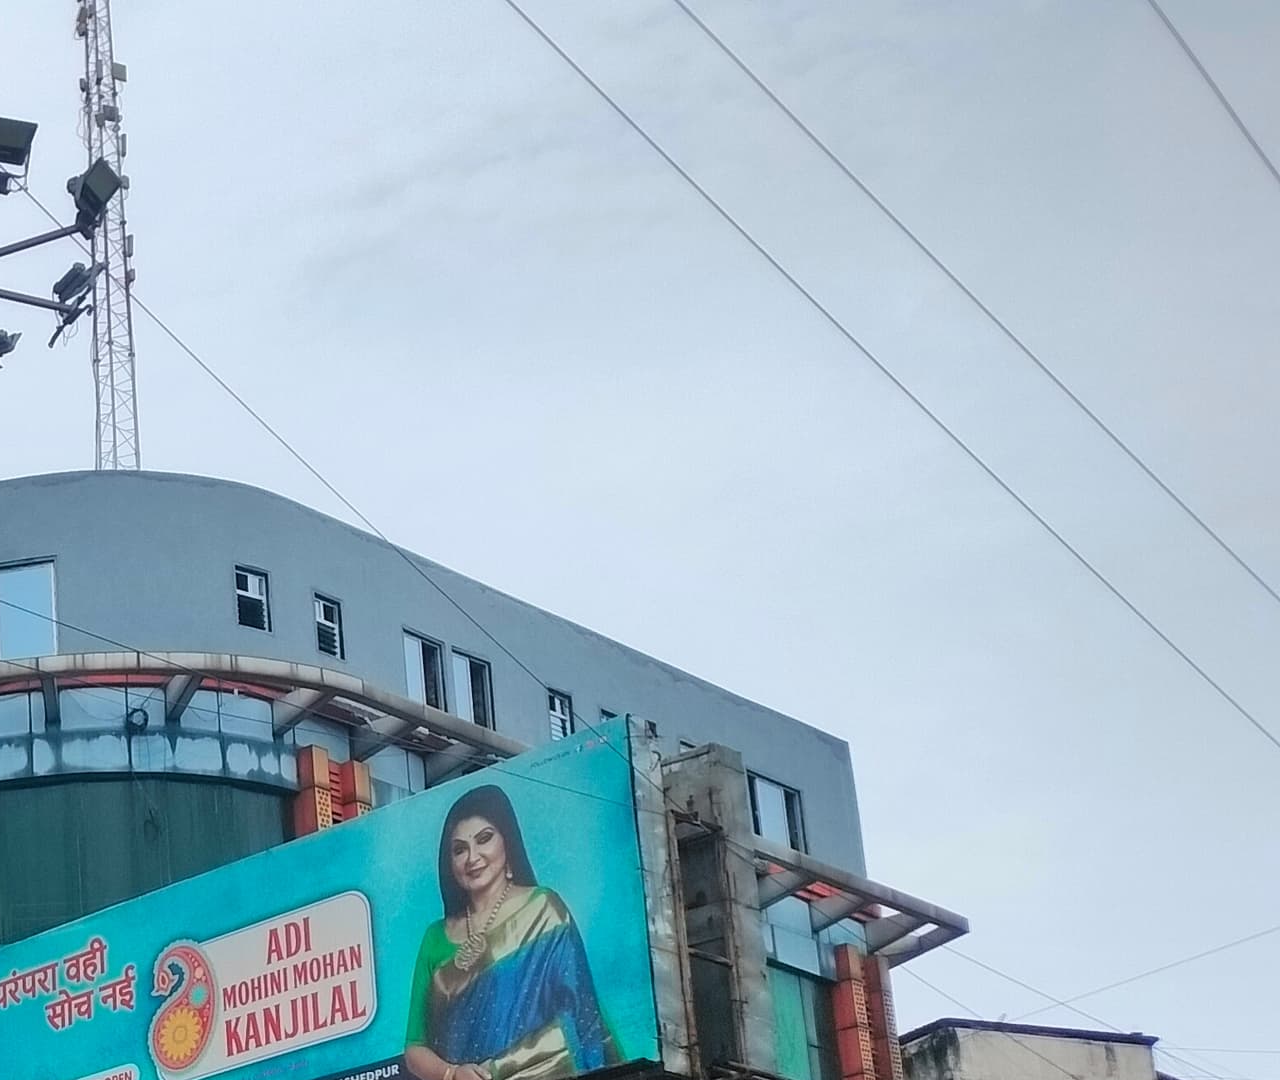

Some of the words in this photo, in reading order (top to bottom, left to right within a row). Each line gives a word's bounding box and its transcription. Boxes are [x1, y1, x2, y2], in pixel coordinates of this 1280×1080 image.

[64, 937, 108, 983] वही
[266, 917, 313, 966] ADI
[45, 991, 94, 1033] सोच
[100, 966, 136, 1011] नई
[222, 964, 290, 1012] MOHINI
[292, 943, 363, 988] MOHAN
[224, 979, 368, 1058] KANJILAL
